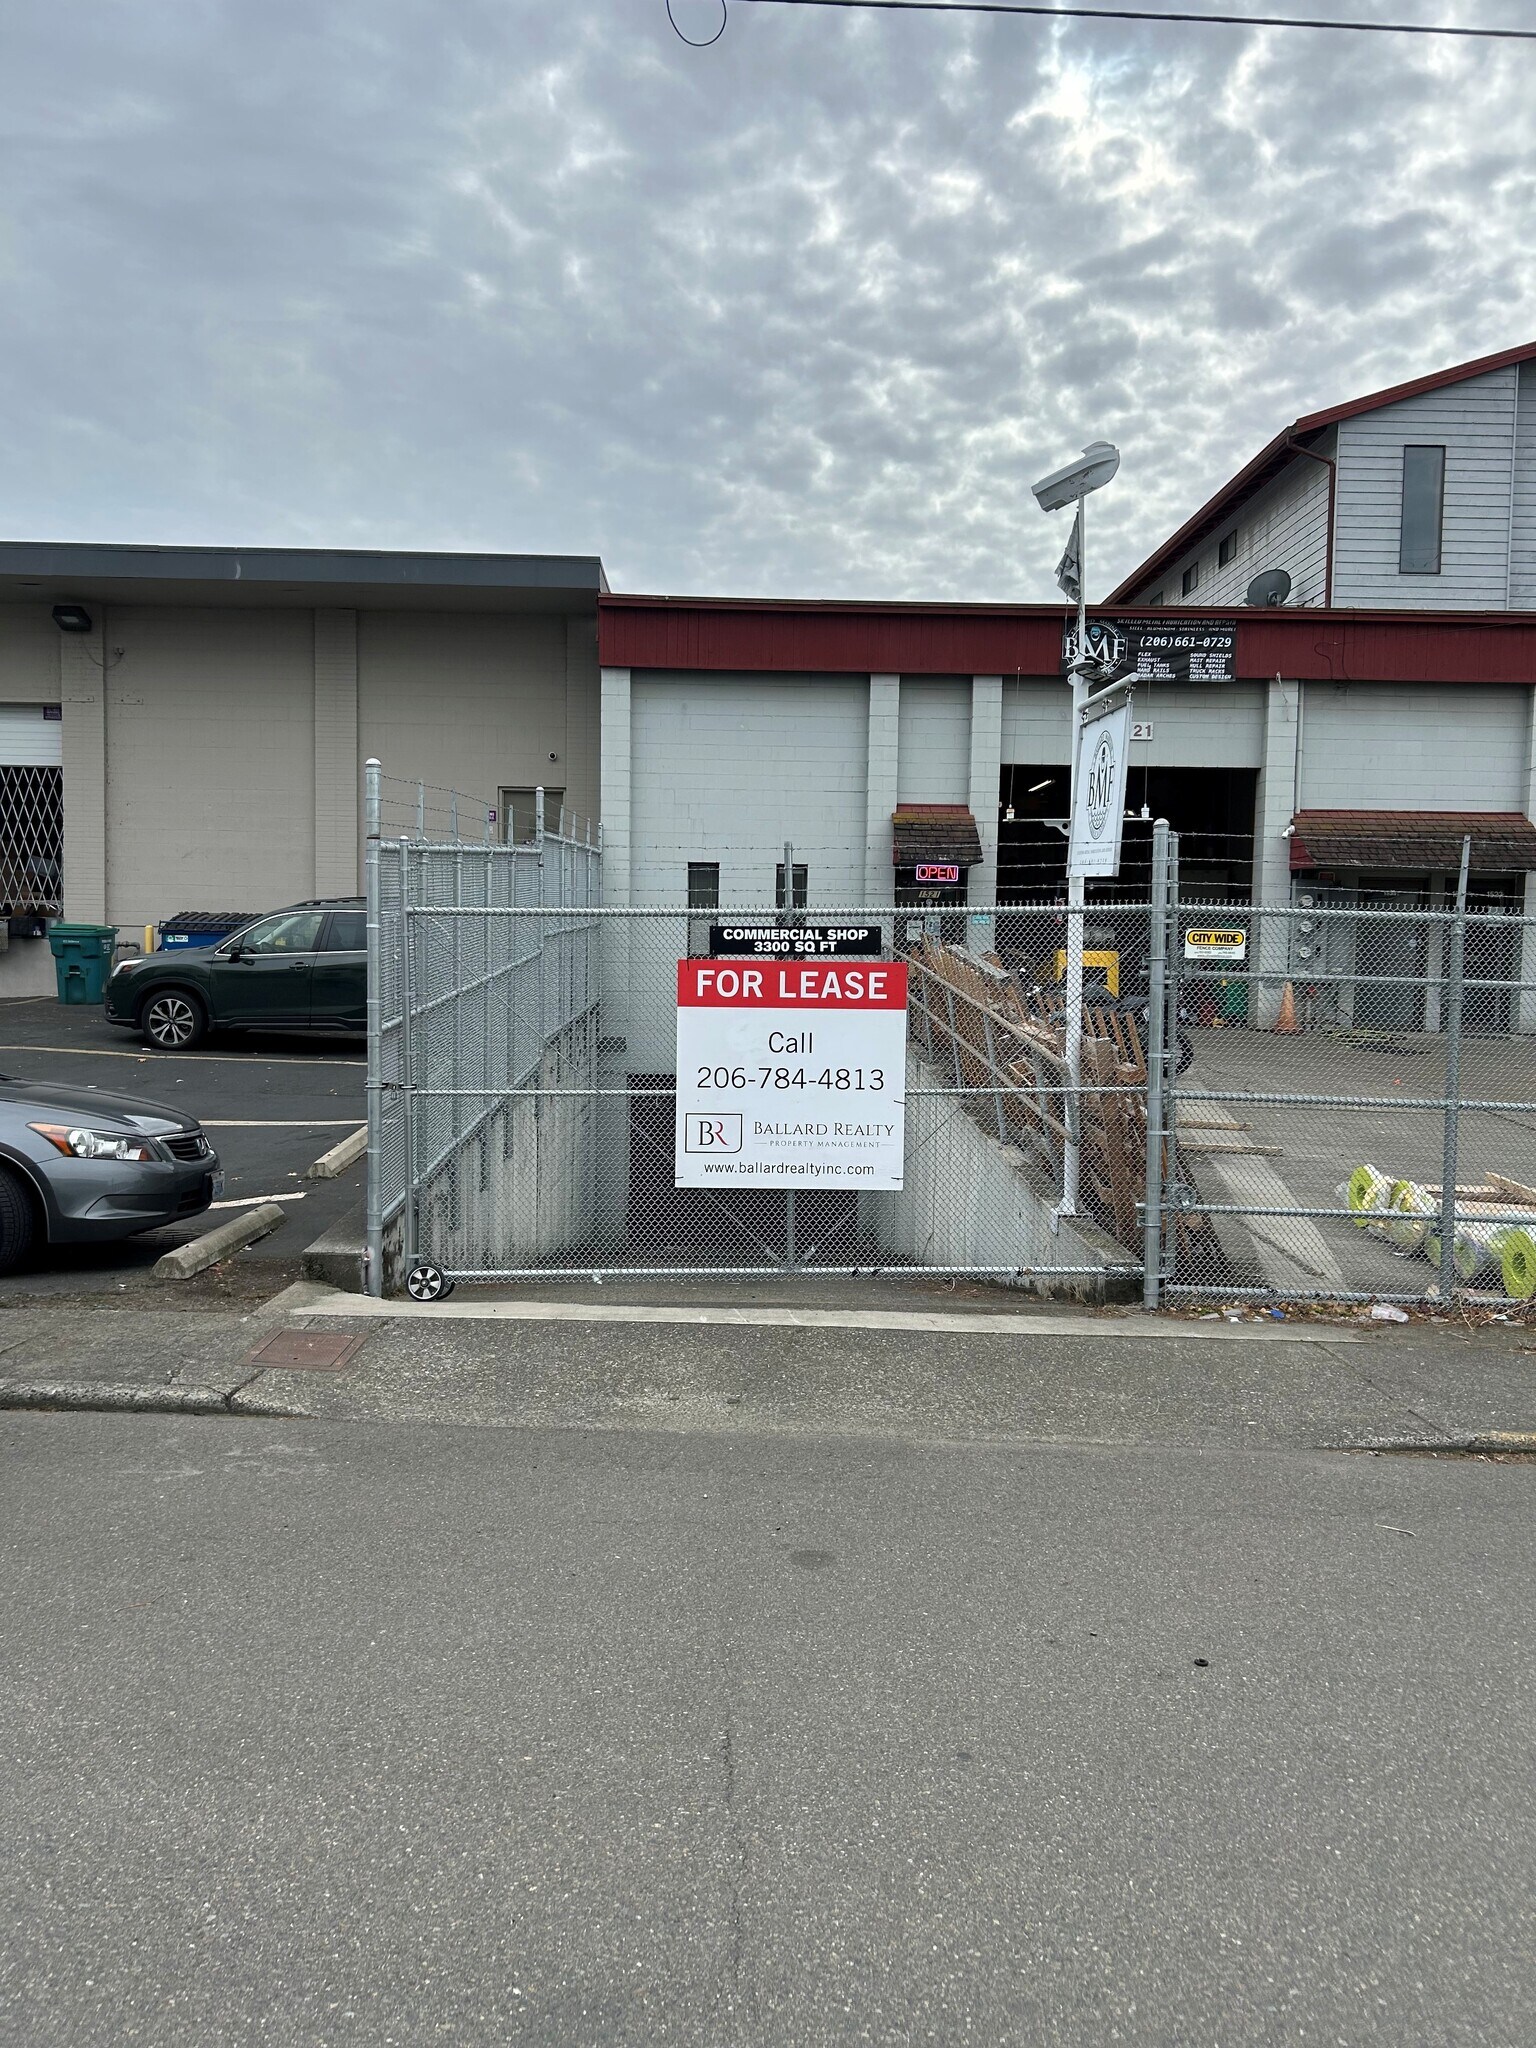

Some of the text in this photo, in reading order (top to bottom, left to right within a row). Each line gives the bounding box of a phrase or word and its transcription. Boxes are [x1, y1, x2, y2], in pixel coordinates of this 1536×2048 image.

[1064, 635, 1125, 662] BMF
[1139, 636, 1232, 648] (206)661-0729
[1088, 765, 1115, 811] BMF
[918, 866, 957, 880] OPEN
[723, 928, 869, 943] COMMERCIAL SHOP
[1192, 933, 1240, 945] CITY WIDE
[753, 941, 838, 955] 3300 SQ FT
[696, 969, 889, 1002] FOR LEASE
[768, 1031, 814, 1054] Call
[696, 1066, 885, 1091] 206-784-4813
[697, 1120, 730, 1148] BR
[753, 1121, 896, 1138] BALLARD REALTY
[769, 1140, 881, 1149] PROPERTY MANAGEMENT
[703, 1161, 875, 1178] www.ballardrealtyinc.com
